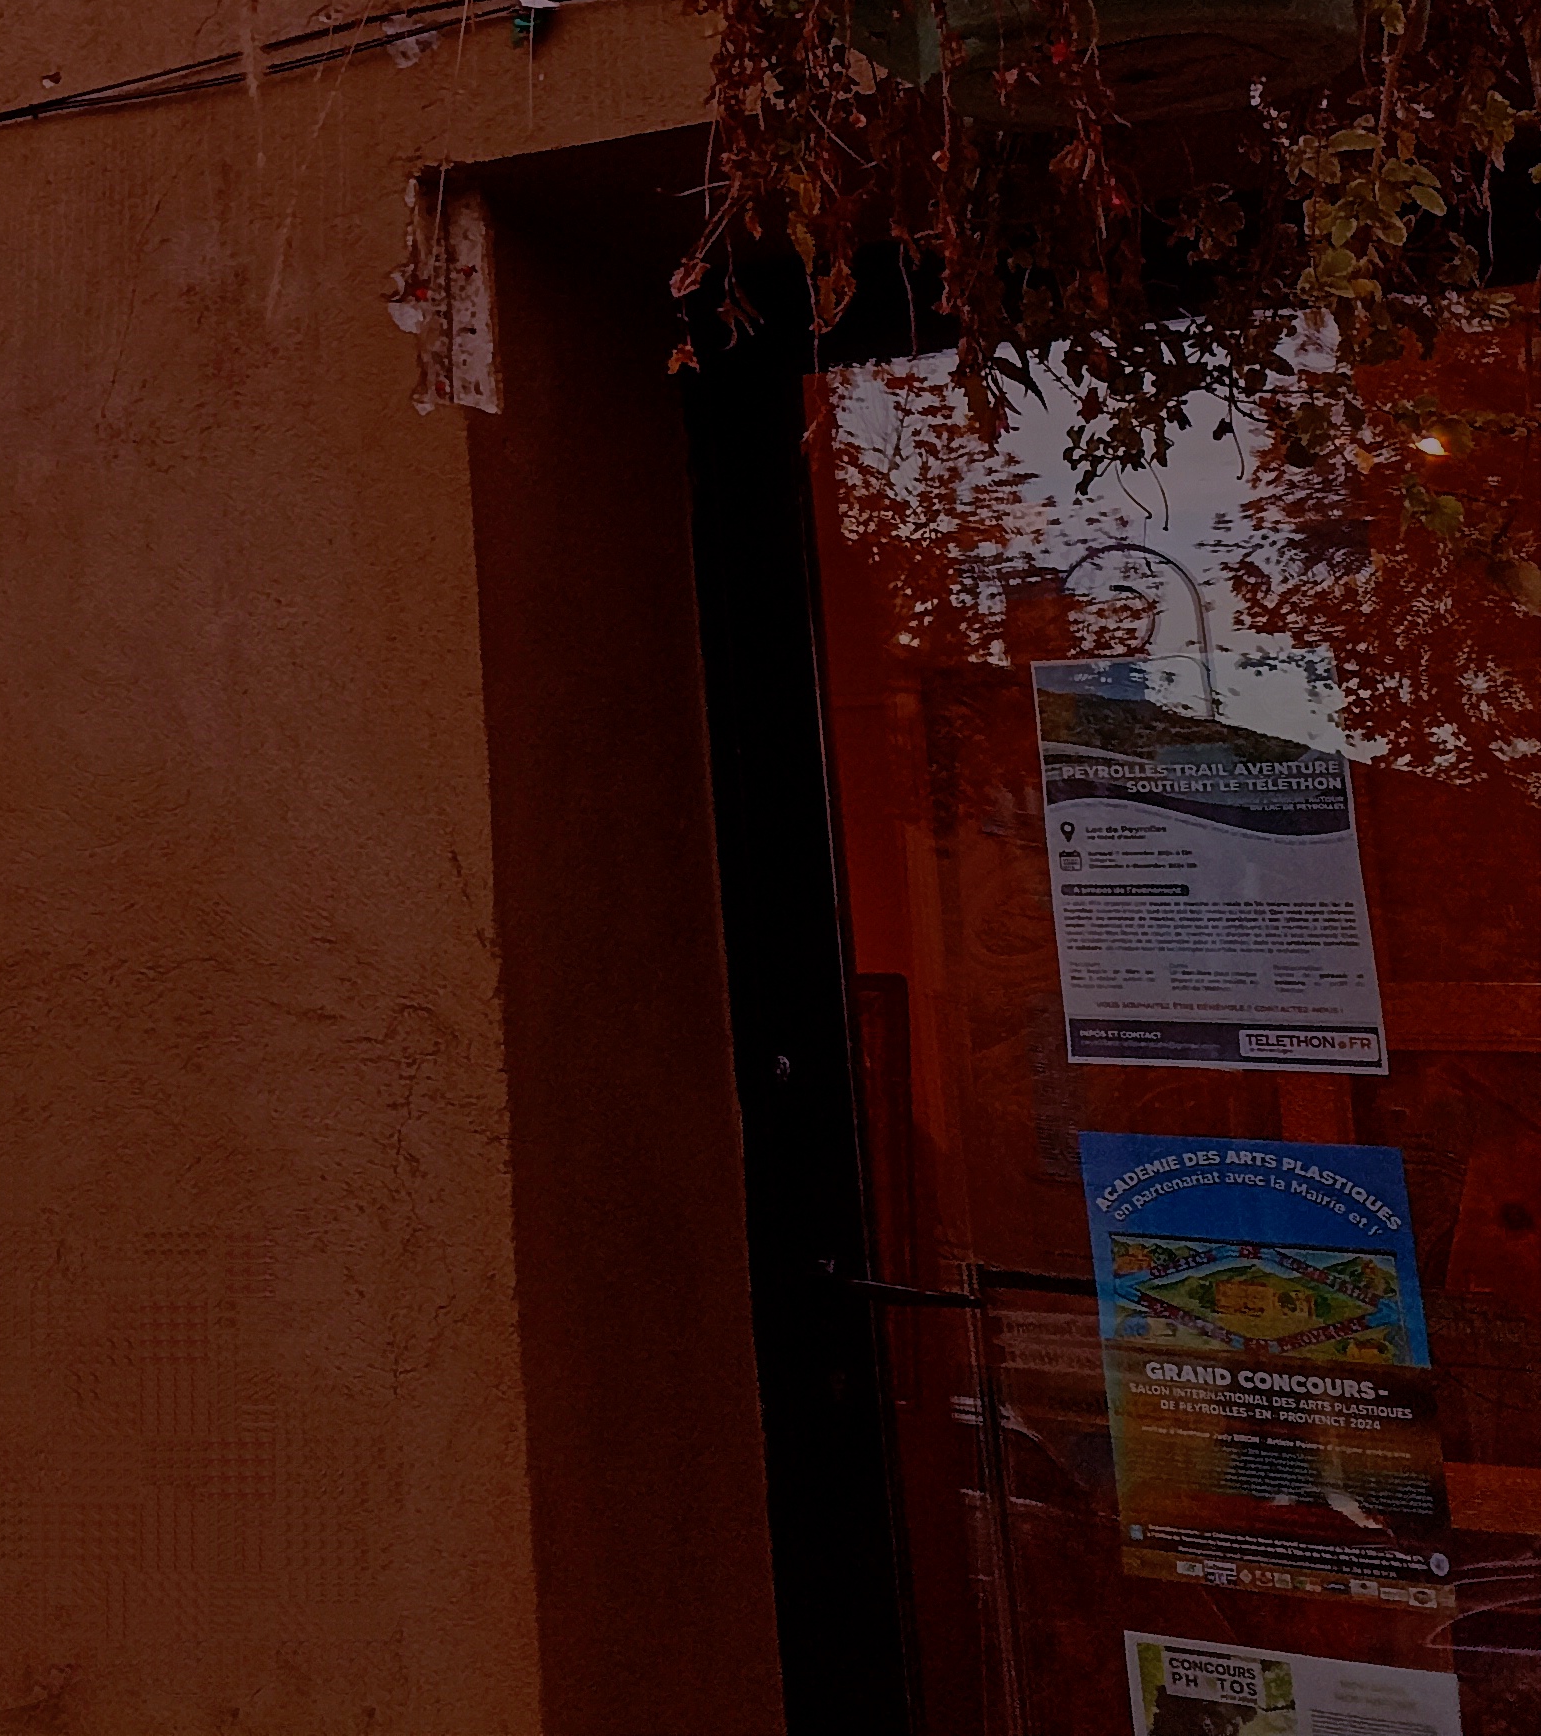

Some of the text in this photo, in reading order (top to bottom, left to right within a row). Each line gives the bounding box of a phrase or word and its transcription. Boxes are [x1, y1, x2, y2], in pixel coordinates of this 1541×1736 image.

[1062, 761, 1339, 780] PEYROLLES TRAIL AVENTURE
[1127, 779, 1214, 793] SOUTIENT
[1221, 779, 1242, 792] LE
[1096, 1150, 1403, 1231] ACADEMIE DES ARTS PLASTIQUES
[1114, 1202, 1132, 1222] en
[1132, 1172, 1221, 1210] partenariat
[1224, 1172, 1266, 1187] avec
[1269, 1174, 1286, 1191] la
[1290, 1179, 1346, 1216] Mairie
[1347, 1210, 1368, 1230] et
[1145, 1361, 1232, 1387] GRAND
[1129, 1382, 1413, 1421] SALON INTERNATIONAL DES ARTS PLASTIQUES
[1160, 1399, 1176, 1411] DE
[1349, 1417, 1382, 1432] 2024
[1168, 1656, 1257, 1681] CONCOURS
